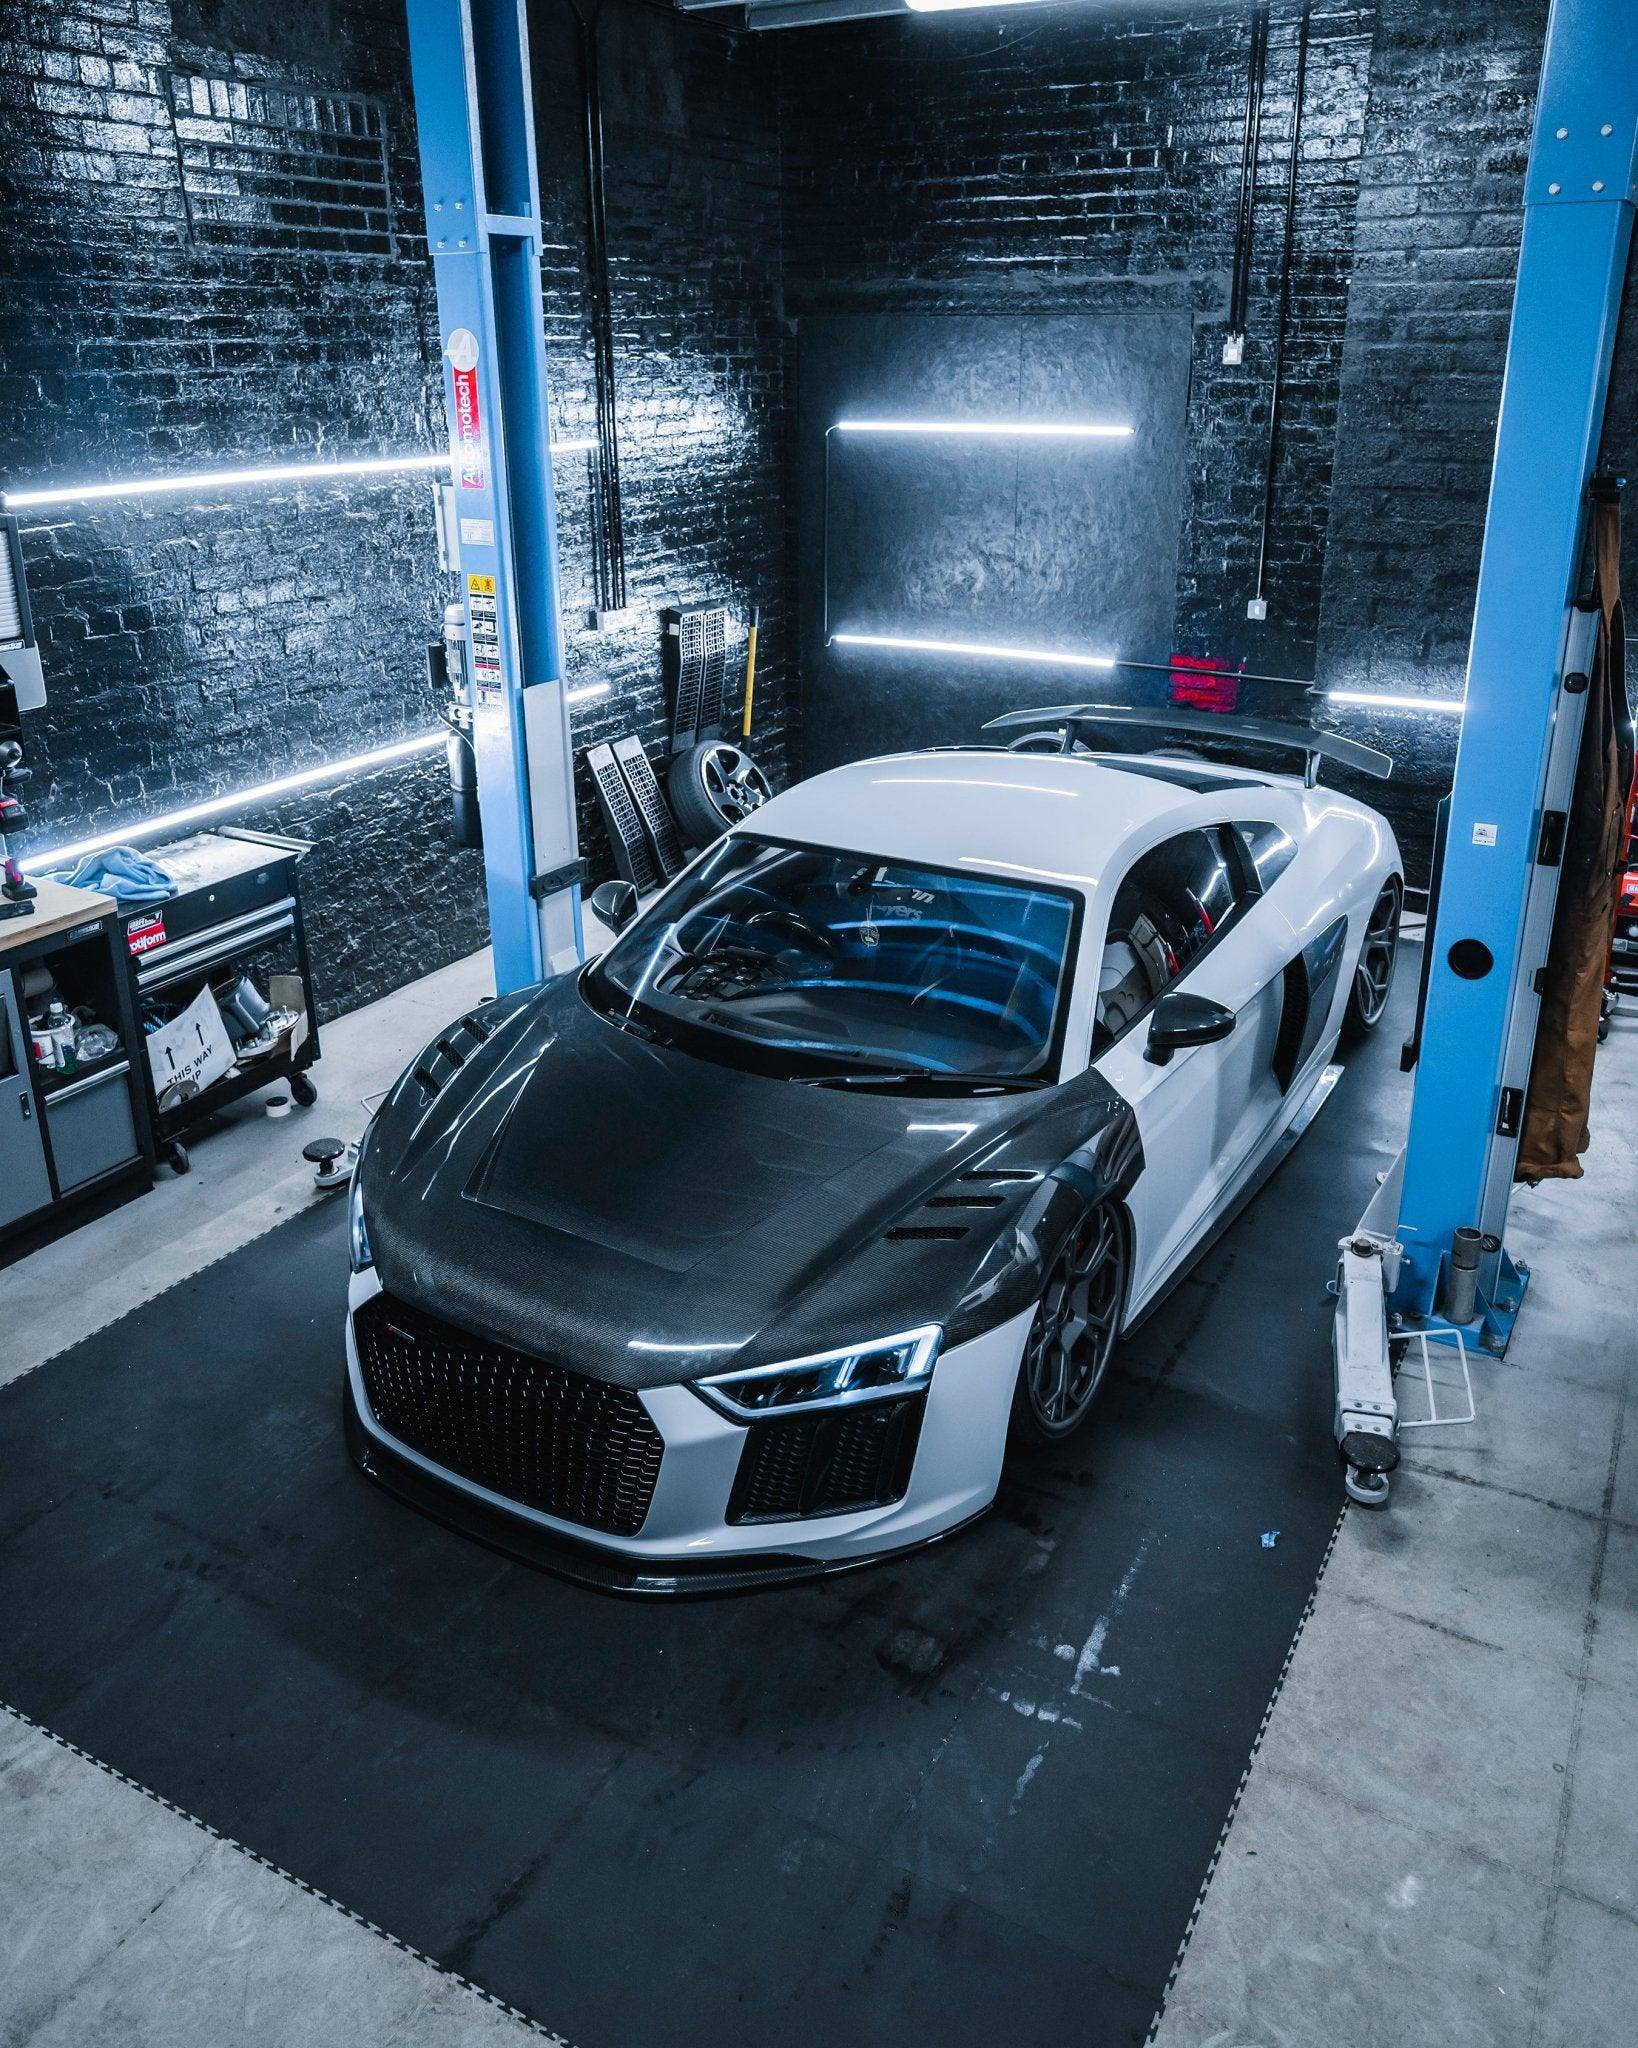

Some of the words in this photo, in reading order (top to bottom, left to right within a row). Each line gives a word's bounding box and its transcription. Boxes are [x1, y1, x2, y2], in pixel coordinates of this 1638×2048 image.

[456, 374, 477, 485] Aomotech
[167, 1065, 191, 1083] THIS
[194, 1045, 213, 1067] WAY
